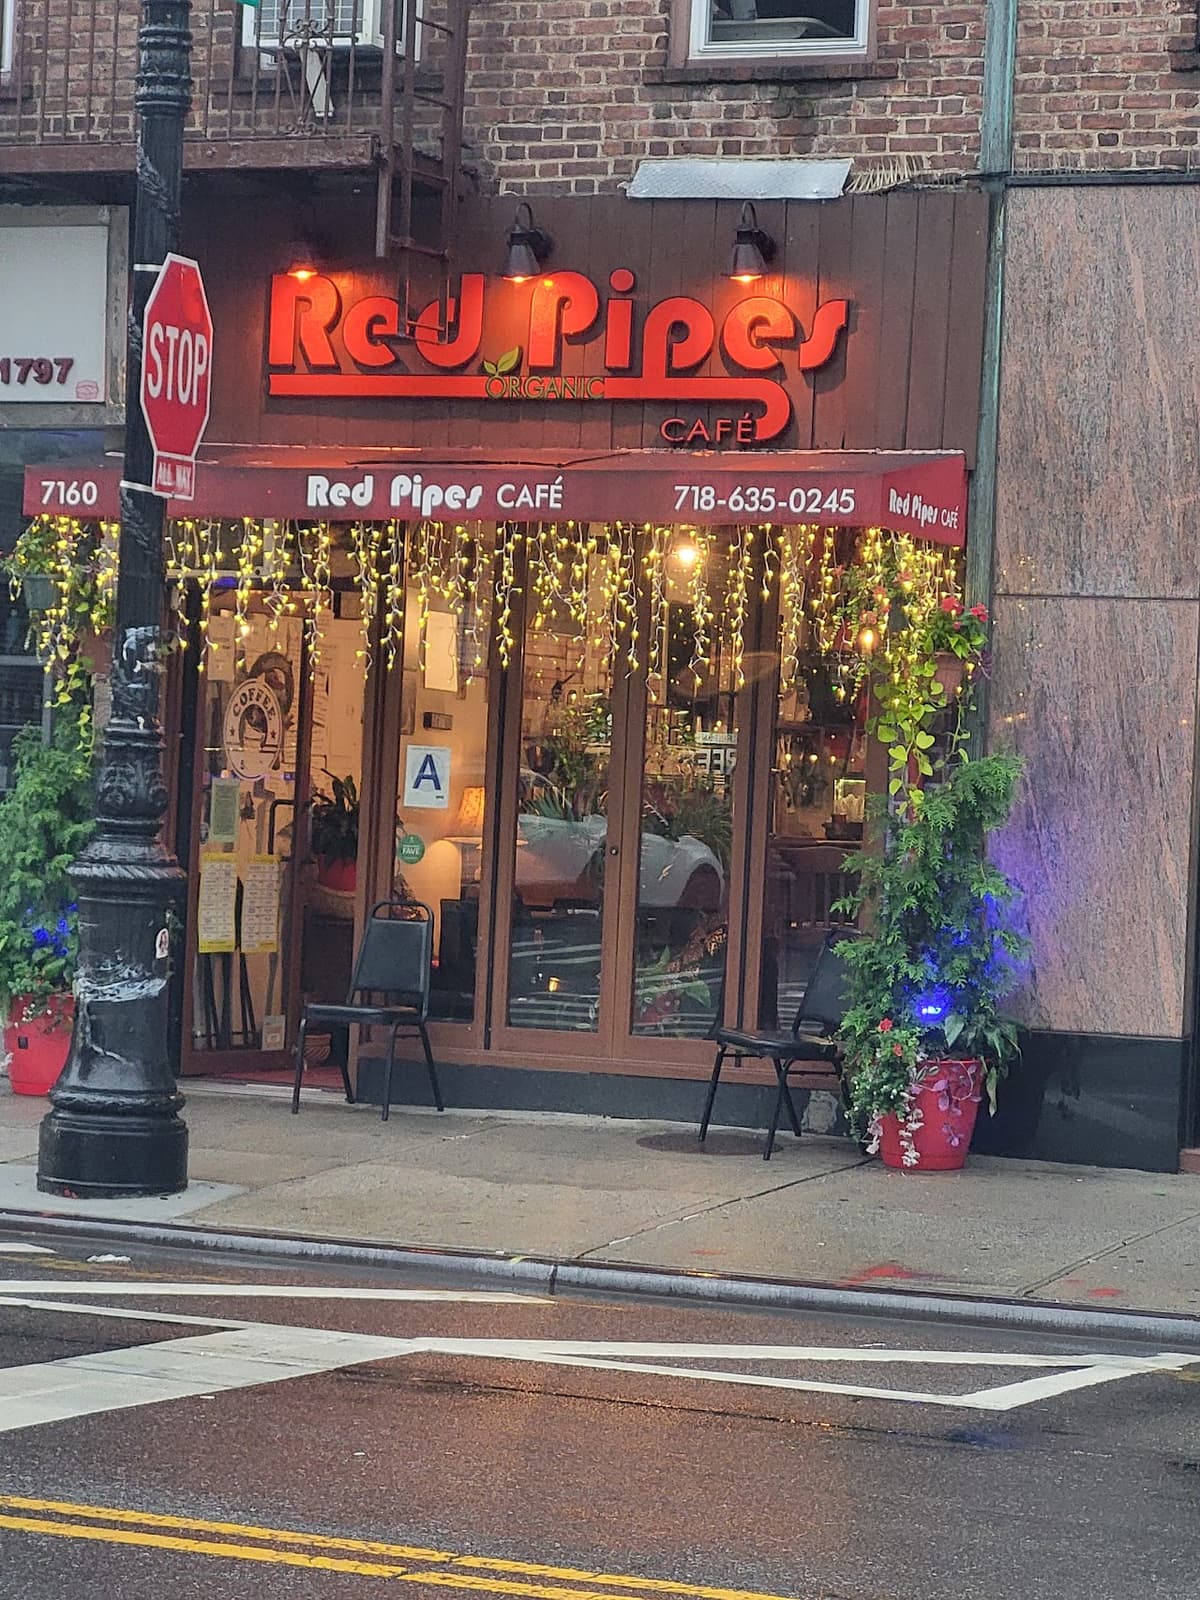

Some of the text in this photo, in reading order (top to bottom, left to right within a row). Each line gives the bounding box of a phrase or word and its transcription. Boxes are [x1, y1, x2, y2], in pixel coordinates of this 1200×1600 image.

[269, 268, 847, 396] Red Pipes
[0, 357, 74, 385] 1797
[147, 321, 208, 406] STOP
[485, 374, 605, 399] ORGANIC
[660, 412, 755, 443] CAFÉ
[157, 461, 192, 491] ALL WAY
[41, 481, 98, 505] 7160
[307, 474, 565, 516] Red Pipes CAFÉ
[674, 485, 856, 514] 718-635-0245
[889, 488, 959, 529] Red Pipes CAFÉ
[232, 687, 276, 721] COFFEE
[412, 753, 442, 790] A
